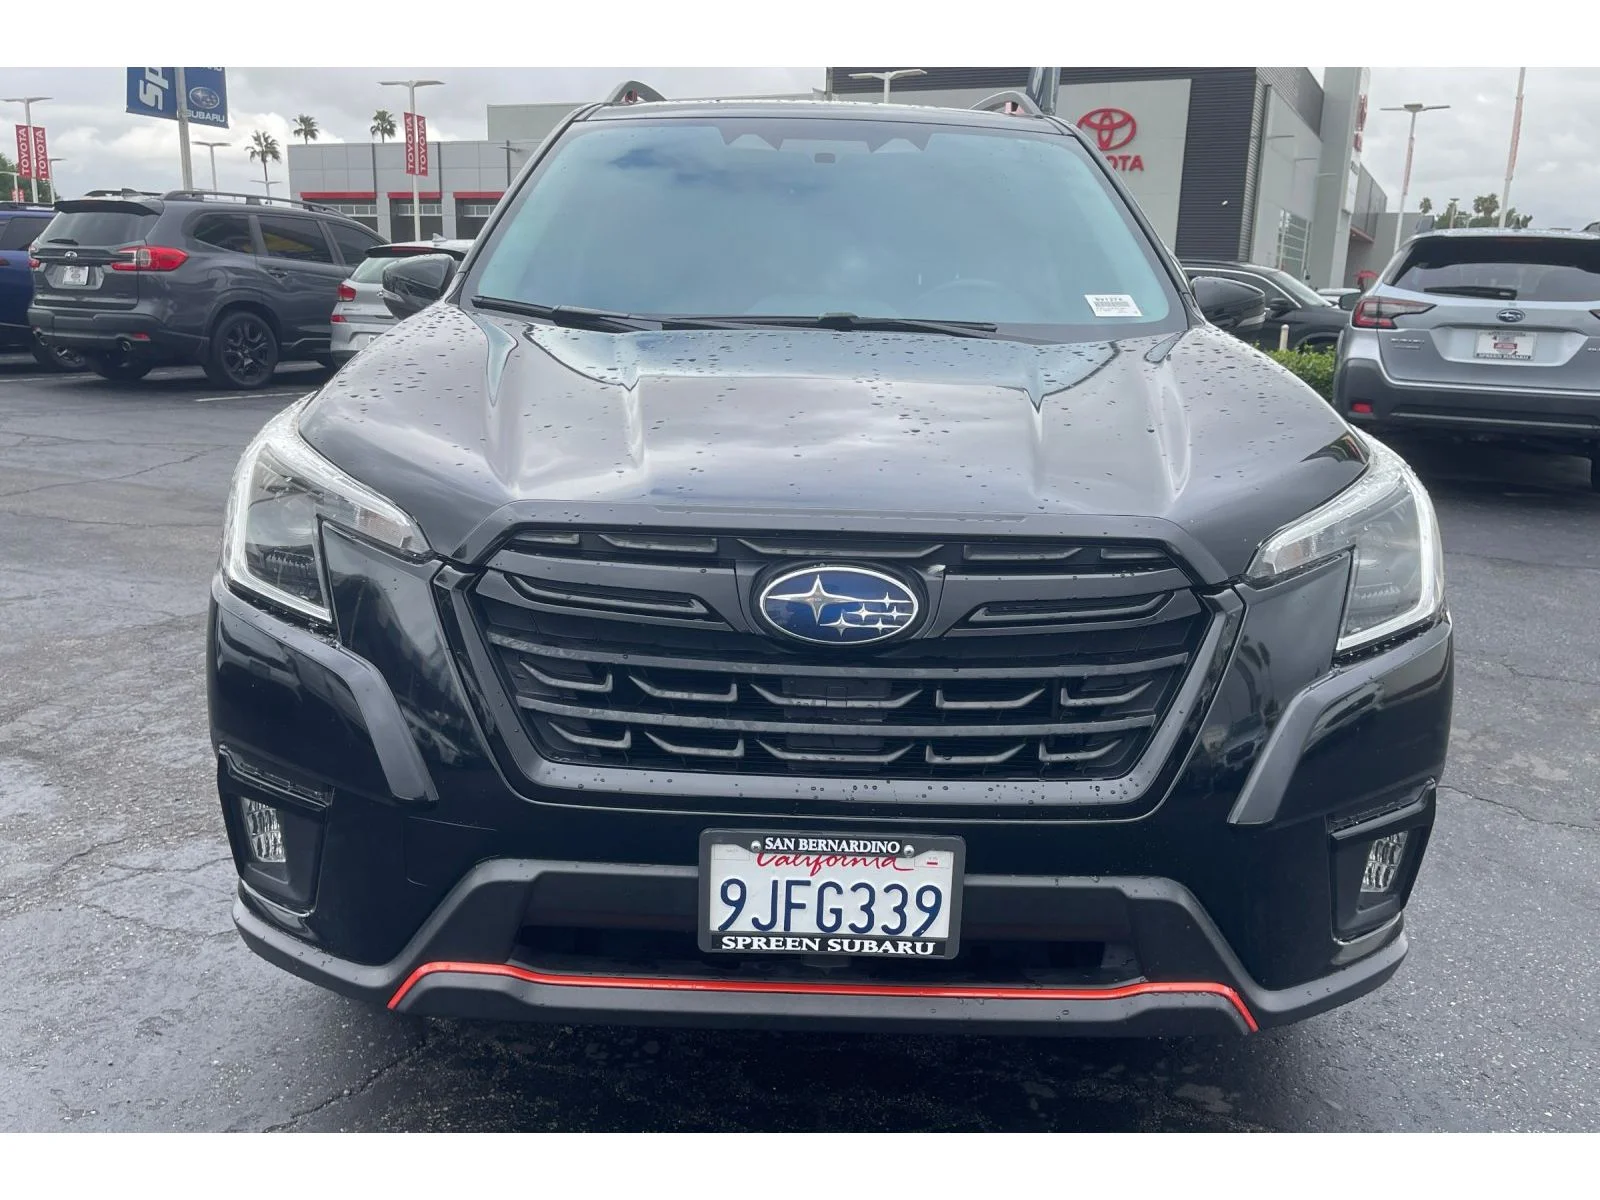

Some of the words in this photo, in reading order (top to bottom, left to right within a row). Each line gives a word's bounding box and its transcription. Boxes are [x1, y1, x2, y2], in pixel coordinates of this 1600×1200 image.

[183, 109, 225, 122] SUBARU
[18, 127, 30, 176] TOYOTA
[35, 129, 48, 177] TOYOTA
[406, 116, 414, 171] TOYOTA
[419, 119, 427, 173] TOYOTA
[1106, 155, 1144, 171] OTA
[764, 837, 796, 851] SAN
[798, 838, 900, 854] BERNARDINO
[756, 852, 915, 876] California
[717, 878, 943, 937] 9JFG339
[721, 935, 821, 952] SPREEN
[827, 939, 936, 956] SUBARU
